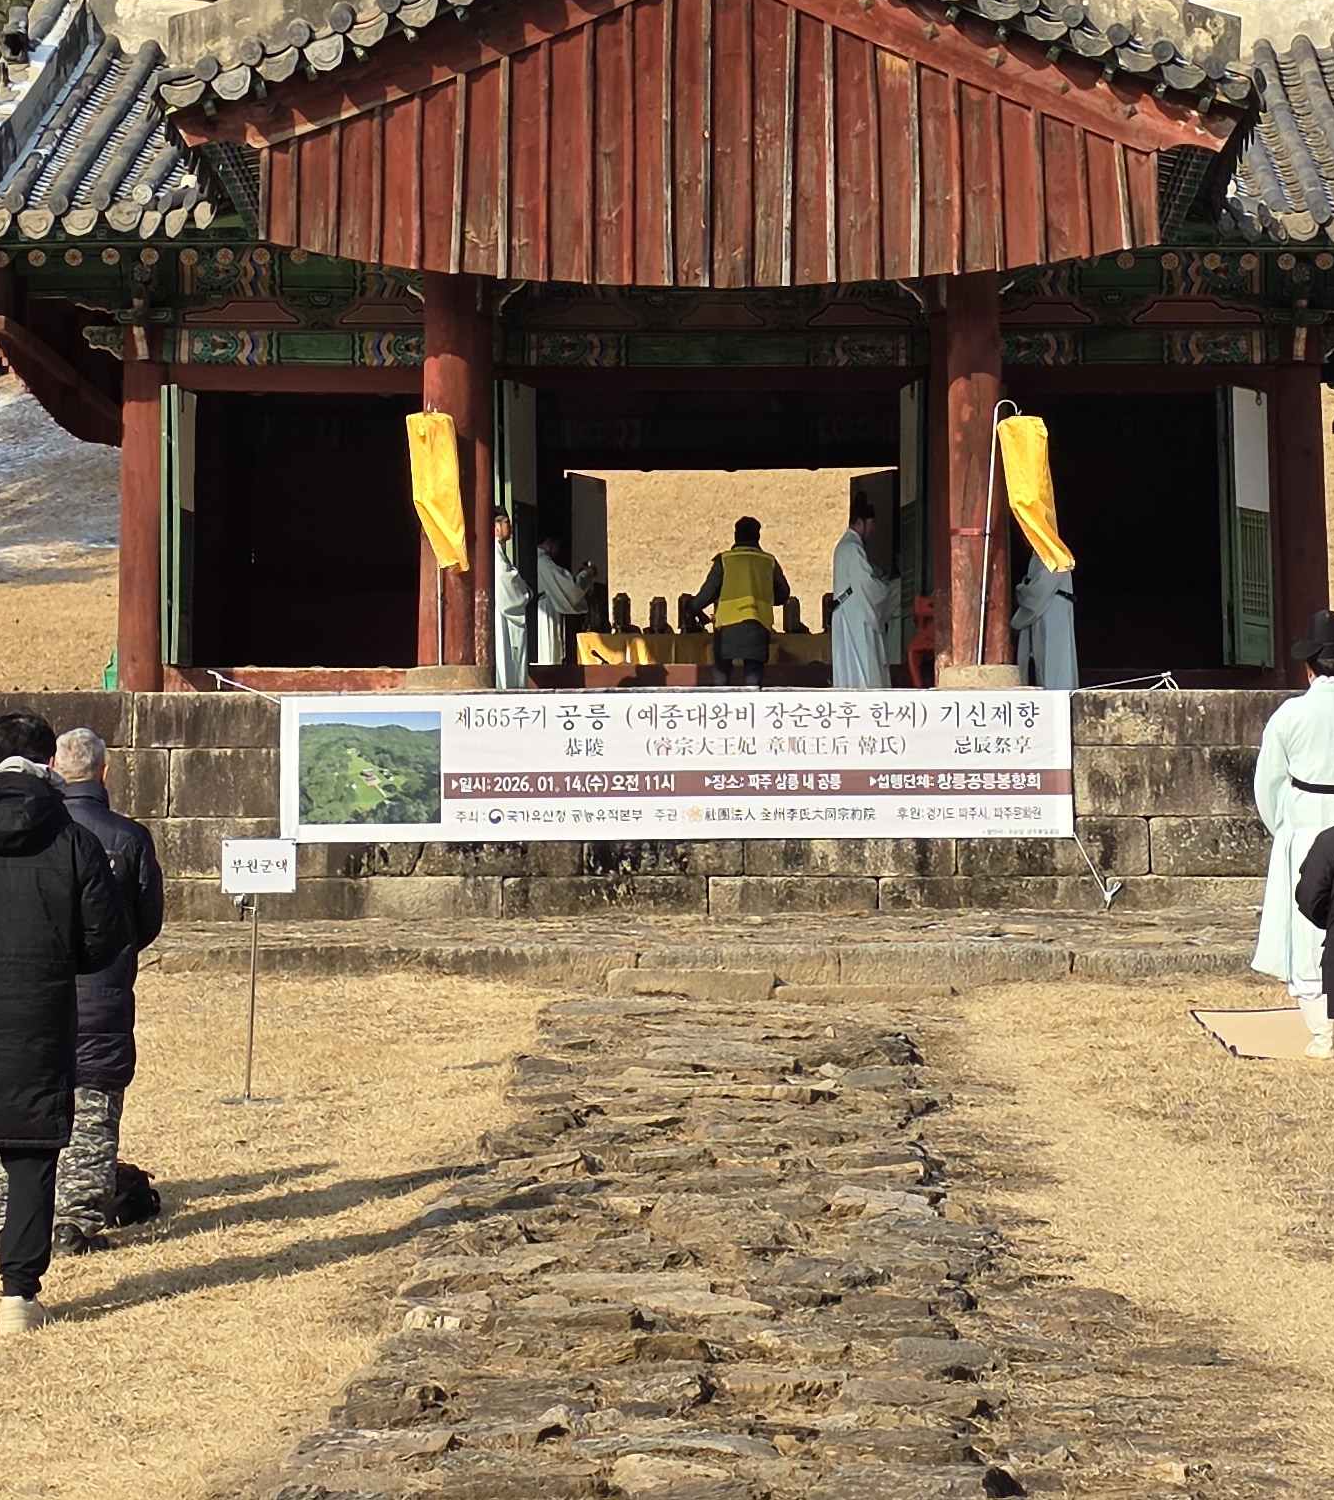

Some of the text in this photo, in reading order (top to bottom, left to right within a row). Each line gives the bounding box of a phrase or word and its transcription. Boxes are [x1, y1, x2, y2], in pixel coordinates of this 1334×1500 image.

[455, 701, 1040, 731] 제565주기 공릉 (예종대왕비 장순왕후 한씨) 기신제향
[459, 776, 491, 793] 일시:
[493, 775, 534, 793] 2026.
[537, 775, 560, 793] 01.
[610, 774, 639, 792] 오전
[644, 774, 675, 793] 11시
[712, 773, 841, 790] 장소: 파주 삼릉 내 공릉
[926, 806, 955, 820] 경기도
